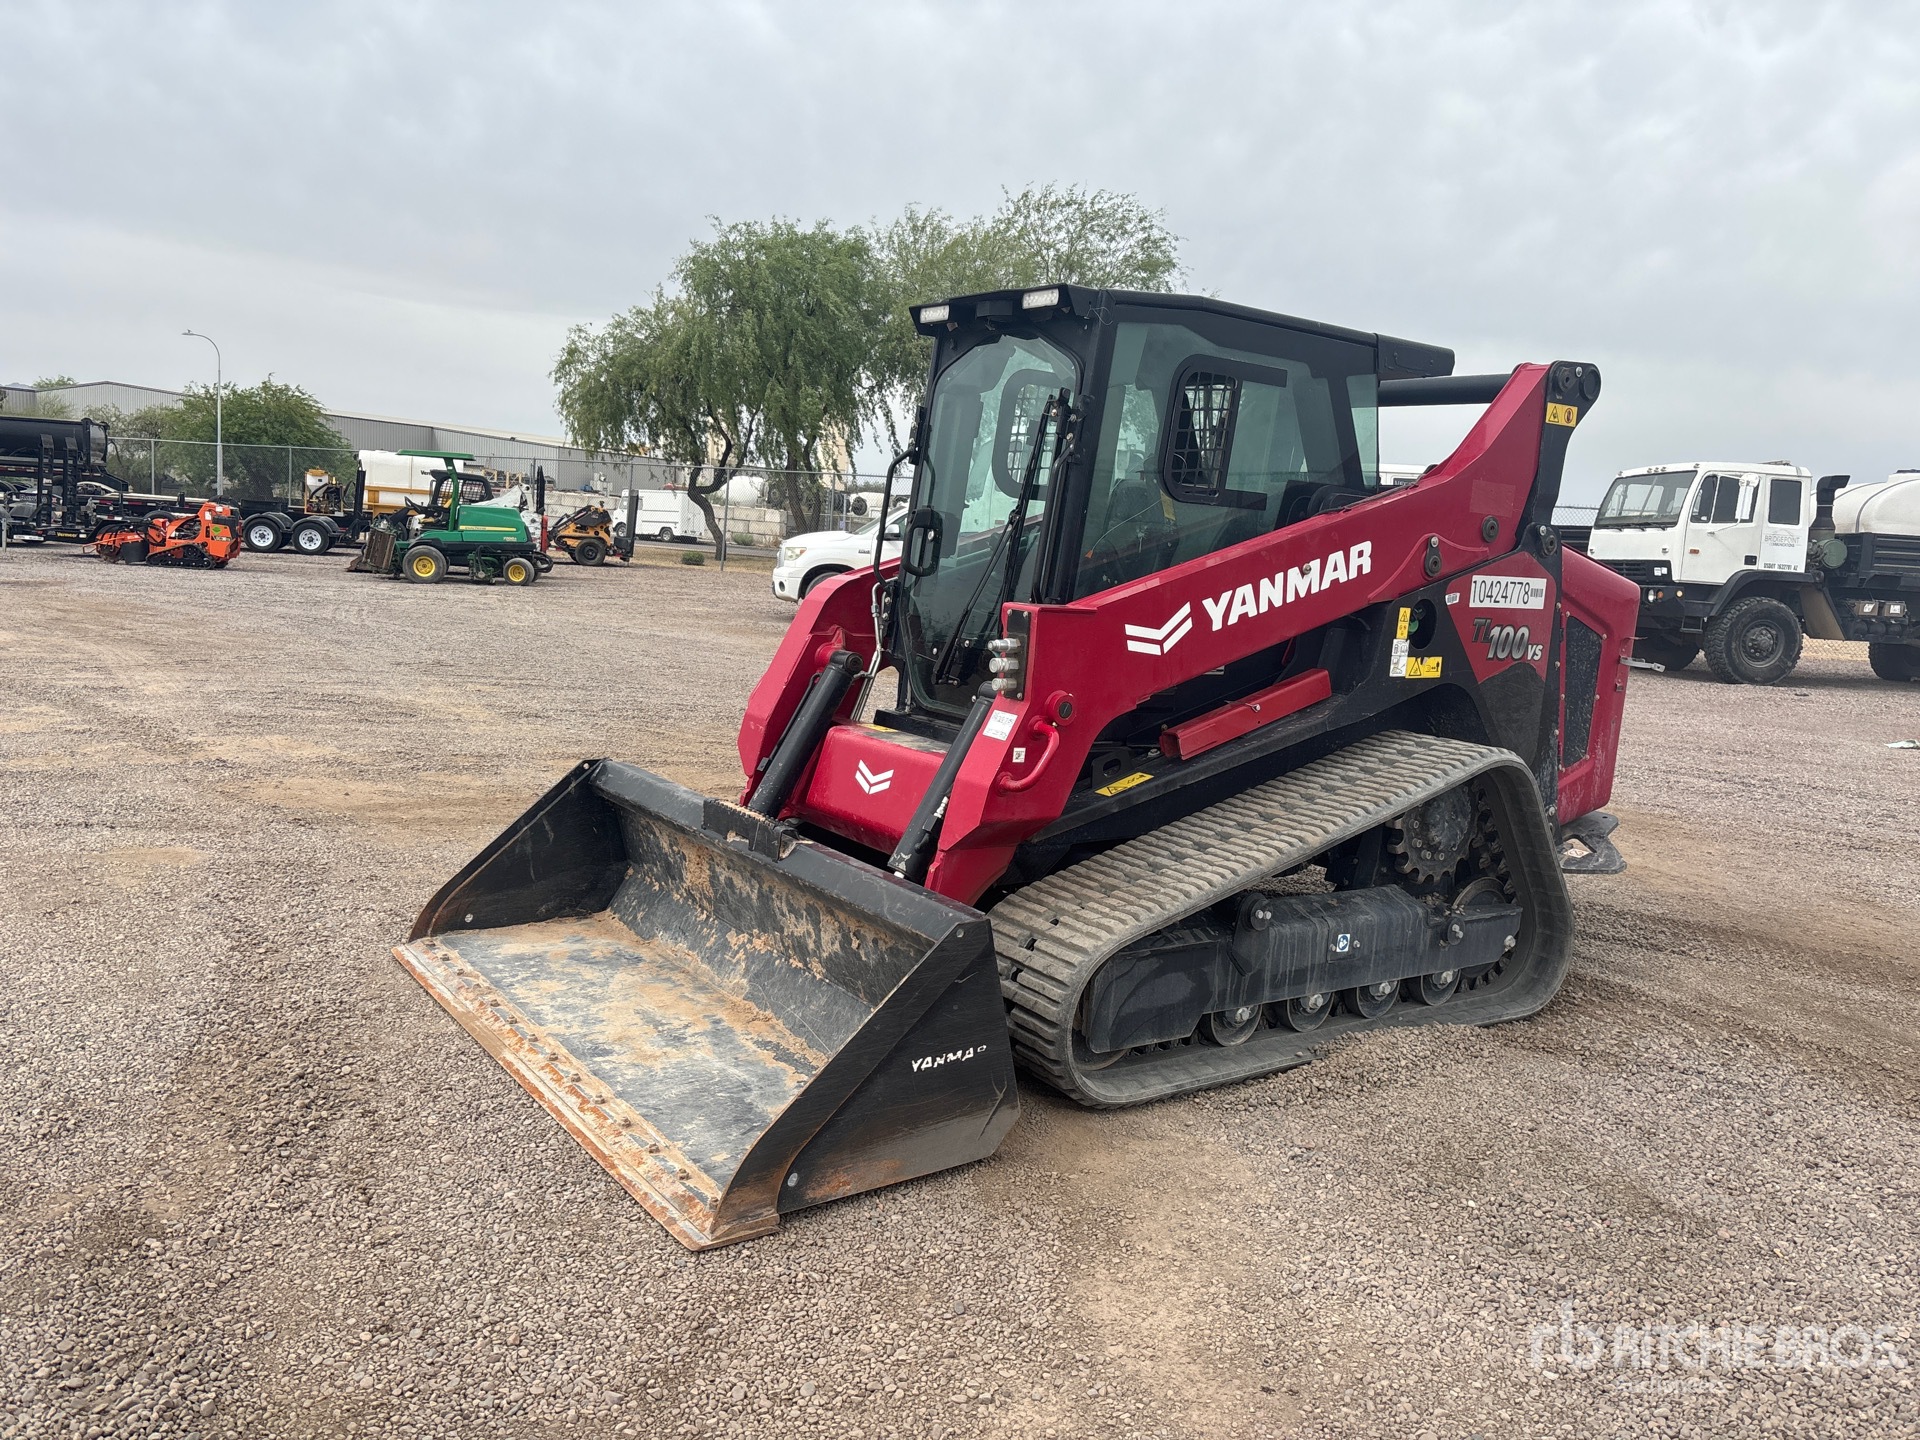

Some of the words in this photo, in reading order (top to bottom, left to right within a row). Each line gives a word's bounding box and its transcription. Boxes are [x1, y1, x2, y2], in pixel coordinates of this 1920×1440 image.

[1764, 534, 1800, 545] BRIDGEPOINT
[1201, 540, 1373, 632] YANMAR
[1472, 579, 1531, 605] 10424778
